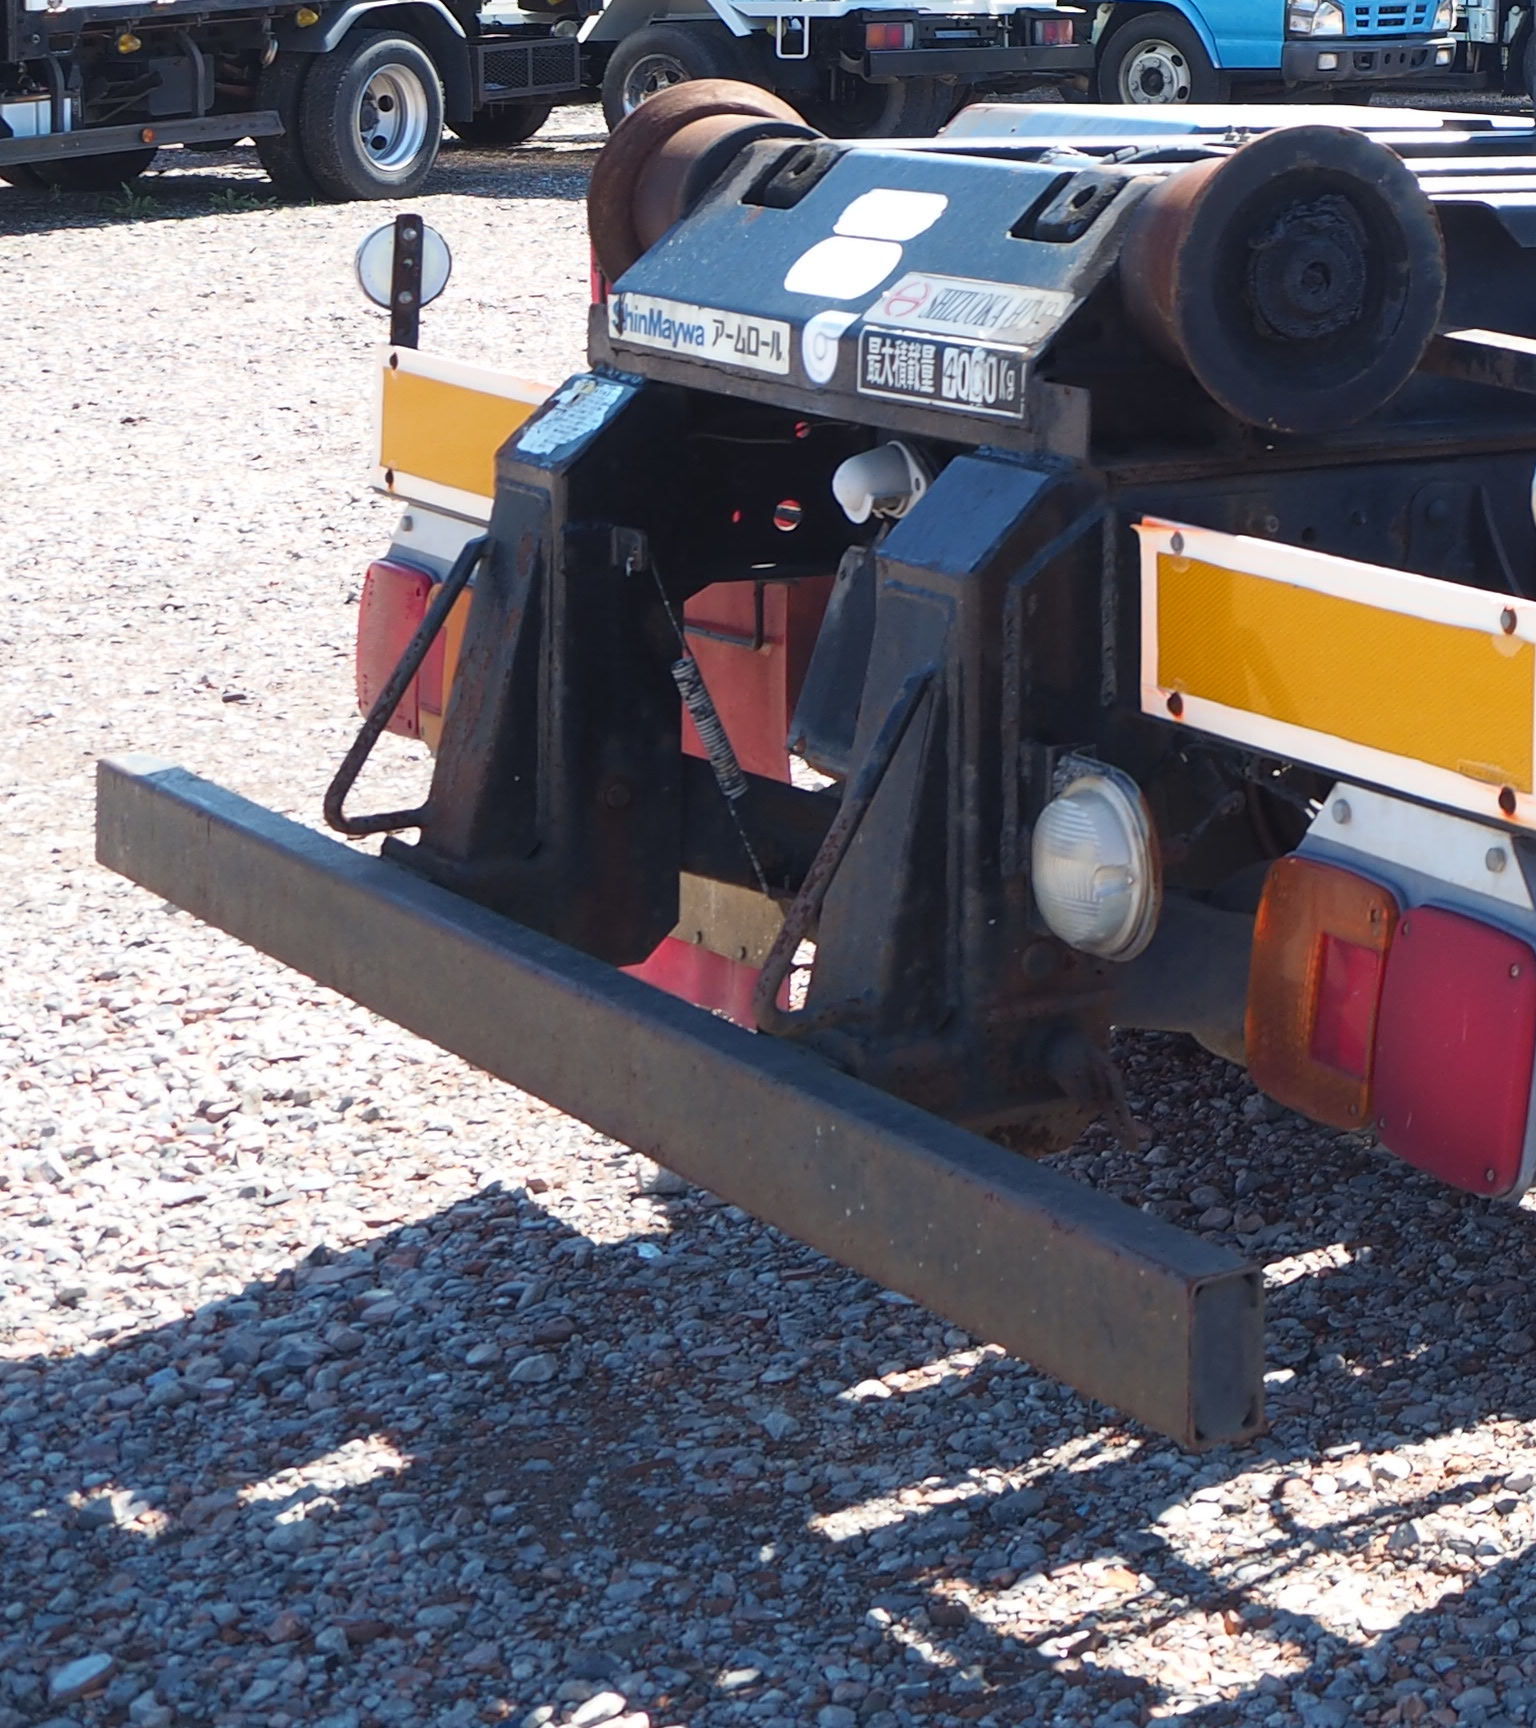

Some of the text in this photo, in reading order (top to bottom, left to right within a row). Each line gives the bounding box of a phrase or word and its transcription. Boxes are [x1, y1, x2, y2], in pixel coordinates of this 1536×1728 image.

[612, 300, 705, 348] ShinMaywa
[918, 288, 1012, 329] SHIZUOKA
[712, 319, 783, 361] アームロール
[866, 336, 937, 393] 最大積載量
